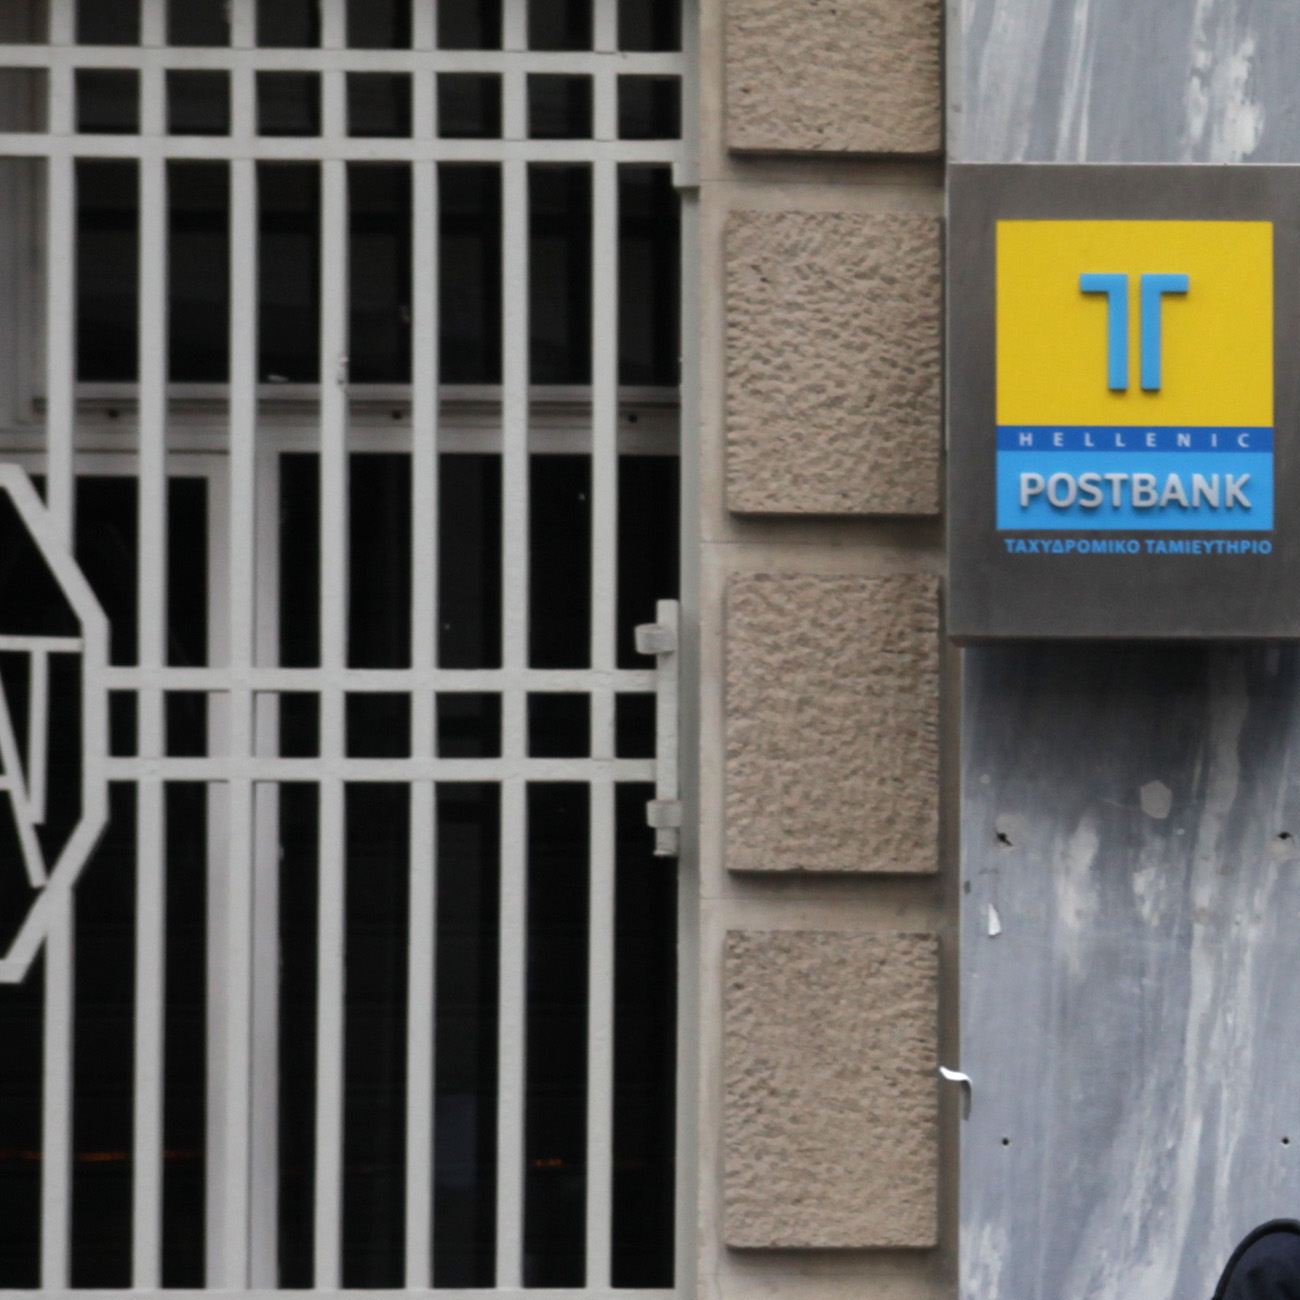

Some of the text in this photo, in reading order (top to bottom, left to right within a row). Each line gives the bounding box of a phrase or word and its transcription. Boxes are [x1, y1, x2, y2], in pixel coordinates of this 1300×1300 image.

[1019, 432, 1250, 448] HELLENIC
[1019, 472, 1252, 509] POSTBANK
[1004, 539, 1273, 555] ΤΑΧΥΔΡΟΜΙΚΟ ΤΑΜΙΕΥΤΗΡΙΟ
